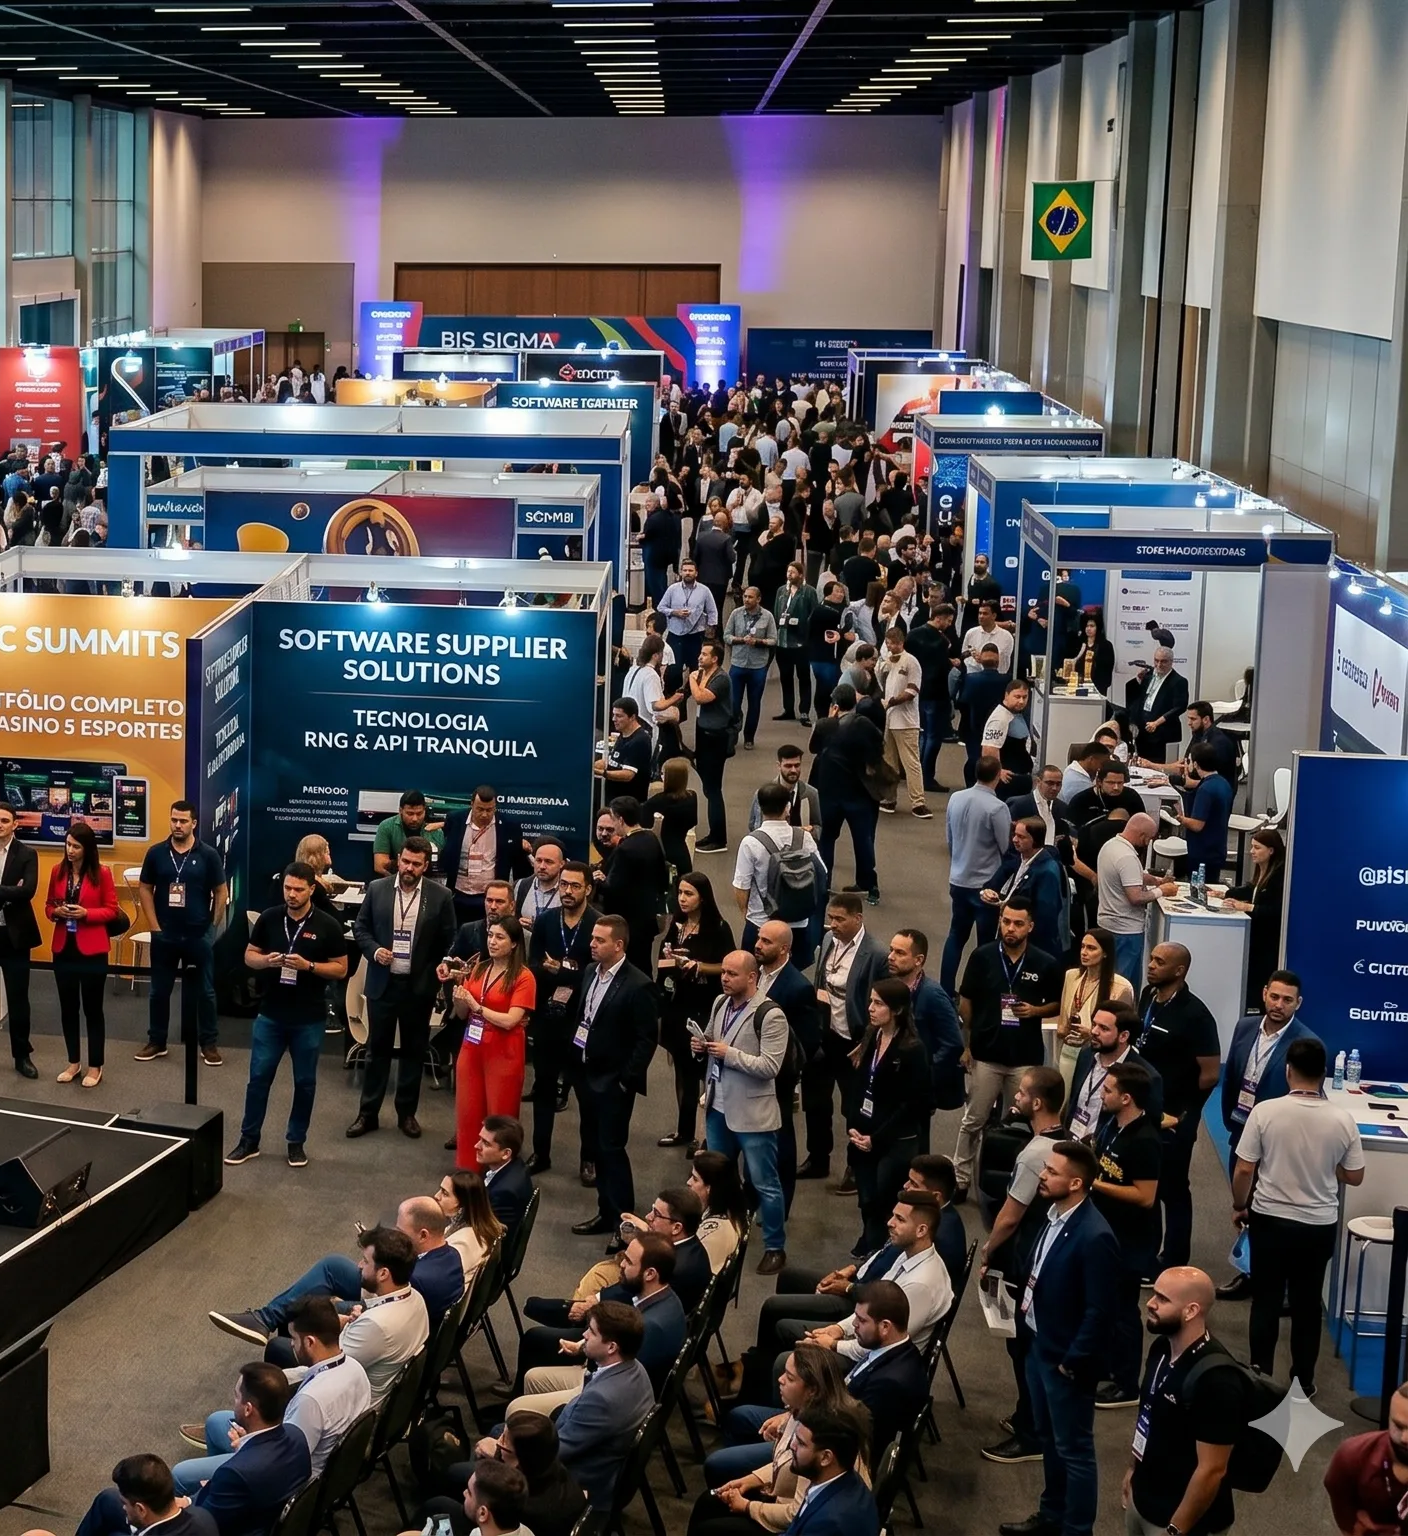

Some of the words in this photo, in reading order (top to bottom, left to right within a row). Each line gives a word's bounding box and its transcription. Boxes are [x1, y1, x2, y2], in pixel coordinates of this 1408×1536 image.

[441, 331, 476, 349] BIS
[482, 332, 556, 350] SIGMA
[512, 397, 578, 408] SOFTWARE
[26, 624, 179, 658] SUMMITS
[279, 629, 429, 654] SOFTWARE
[436, 634, 567, 659] SUPPLIER
[344, 660, 500, 685] SOLUTIONS
[71, 696, 183, 716] COMPLETO
[65, 719, 74, 734] 5
[82, 720, 182, 739] ESPORTES
[353, 710, 488, 731] TECNOLOGIA
[306, 732, 347, 748] RNG
[354, 734, 368, 749] &
[374, 735, 407, 751] API
[414, 737, 537, 758] TRANQUILA
